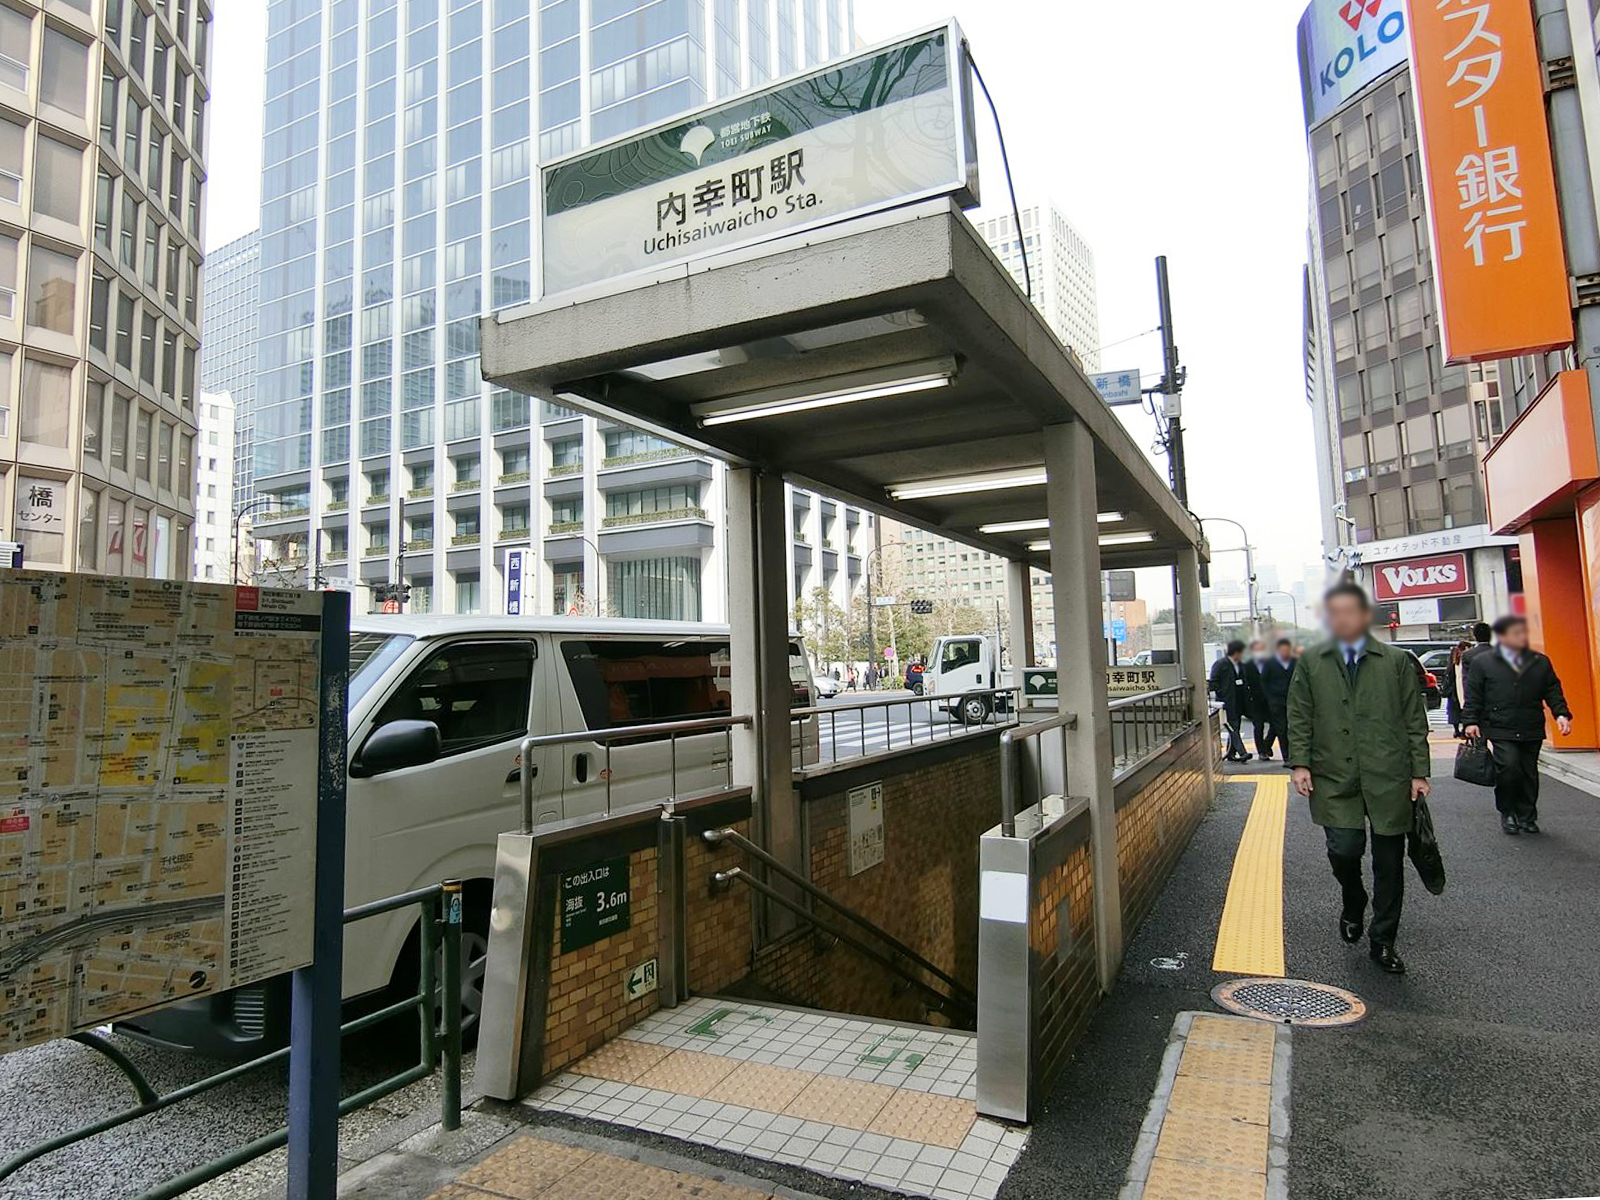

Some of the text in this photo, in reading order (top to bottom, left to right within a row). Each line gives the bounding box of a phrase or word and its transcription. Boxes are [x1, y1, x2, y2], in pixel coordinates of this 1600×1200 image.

[1320, 11, 1405, 97] KOLO
[721, 124, 772, 149] TOEI SUBWAY
[657, 148, 806, 231] 内幸町駅
[643, 192, 824, 255] Uchisaiwaicho Sta.
[29, 485, 53, 508] 橋
[19, 510, 62, 524] センター
[1373, 534, 1462, 556] ユナイテッド不動産
[509, 557, 520, 613] 西新橋
[1381, 564, 1457, 594] VOLKS
[565, 866, 610, 889] この出入口は
[566, 895, 584, 912] 海抜
[596, 891, 628, 912] 3.6m
